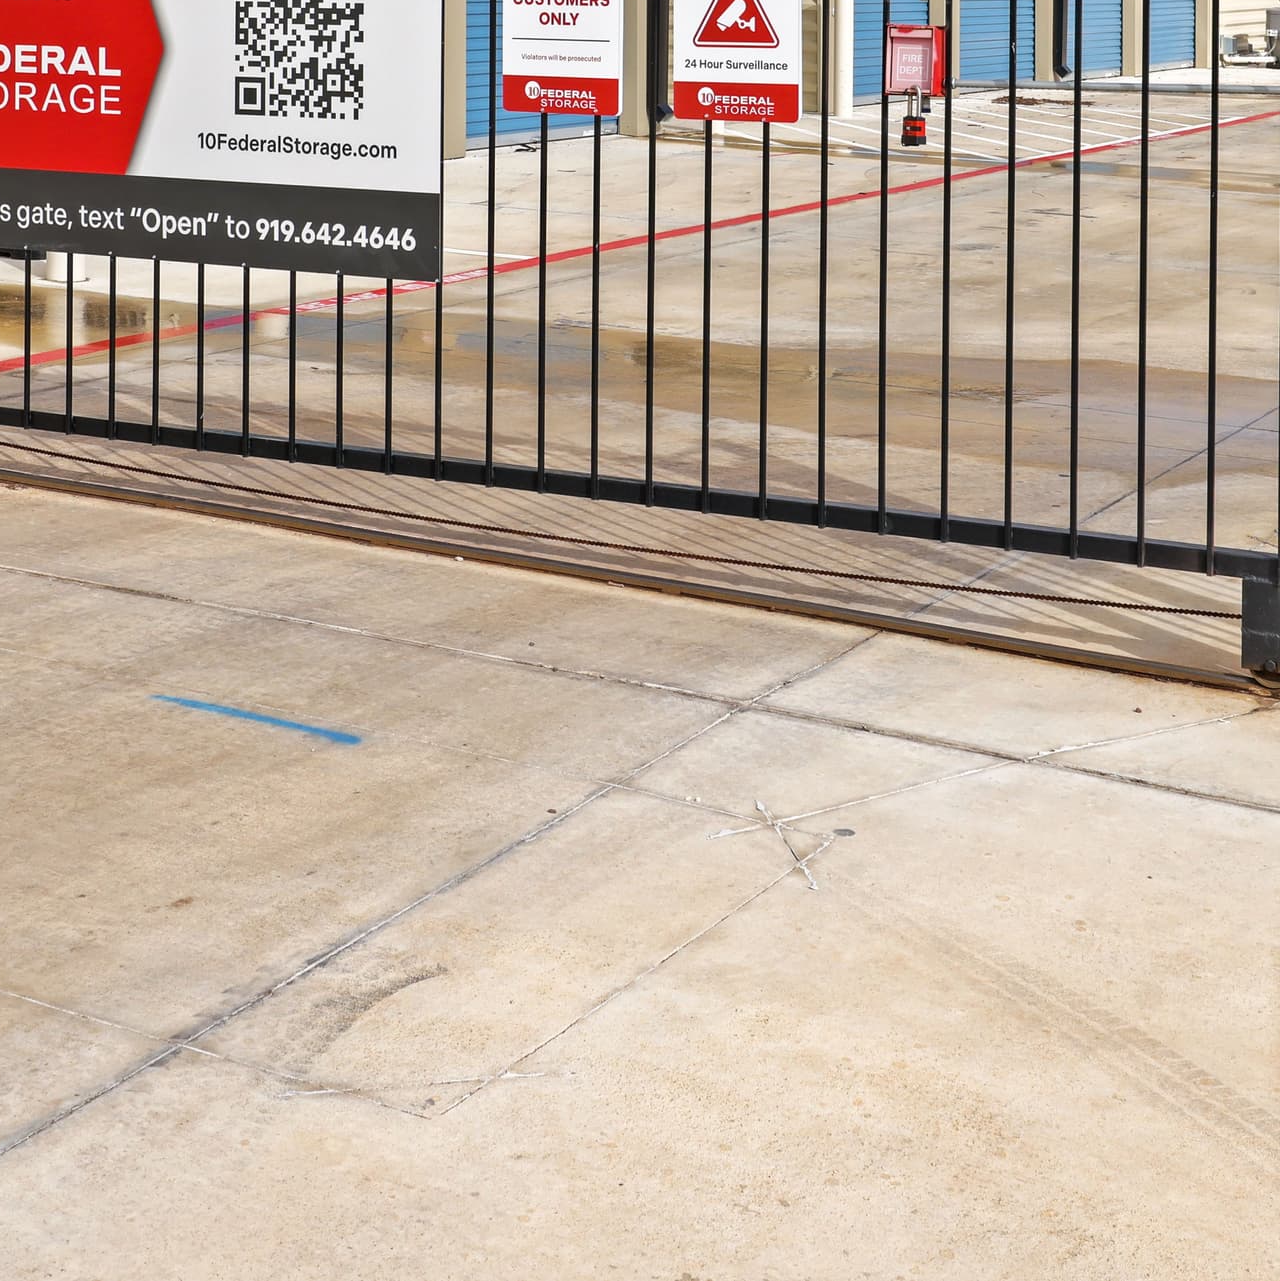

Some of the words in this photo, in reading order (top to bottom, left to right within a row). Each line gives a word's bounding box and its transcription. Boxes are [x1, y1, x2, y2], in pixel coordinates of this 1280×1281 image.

[539, 12, 580, 26] ONLY
[521, 53, 547, 61] Violators
[567, 55, 602, 63] prosecuted
[901, 53, 924, 63] FIRE
[685, 58, 697, 69] 24
[699, 59, 724, 69] Hour
[726, 59, 788, 71] Surveillance
[899, 65, 924, 75] DEPT
[540, 89, 596, 99] FEDERAL
[540, 98, 597, 109] STORAGE
[714, 95, 775, 106] FEDERAL
[714, 104, 775, 116] STORAGE
[197, 132, 398, 161] 10FederalStorage.com
[16, 202, 73, 230] gate,
[78, 205, 125, 230] text
[224, 215, 250, 240] to
[255, 218, 417, 252] 919.642.4646
